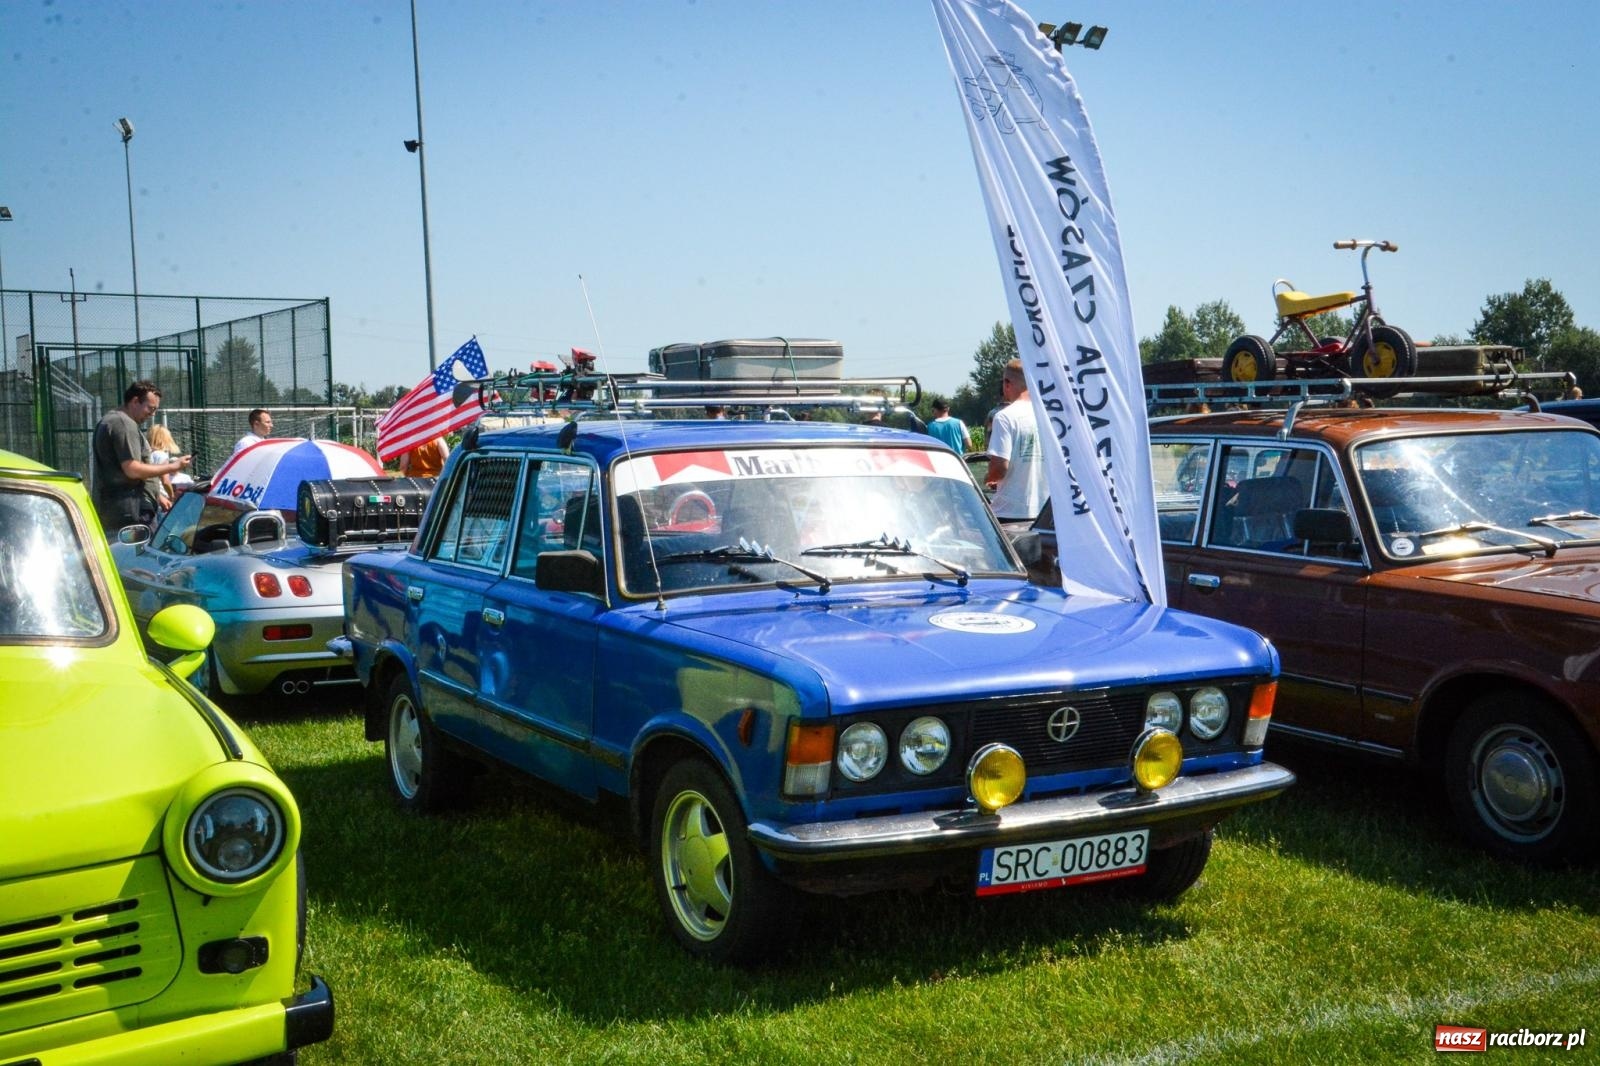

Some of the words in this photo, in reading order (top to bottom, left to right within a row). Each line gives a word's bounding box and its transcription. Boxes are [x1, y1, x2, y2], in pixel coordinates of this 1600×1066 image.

[217, 479, 264, 503] Mobil
[995, 846, 1051, 882] SRC
[1060, 834, 1145, 874] 00883
[979, 872, 991, 882] PL
